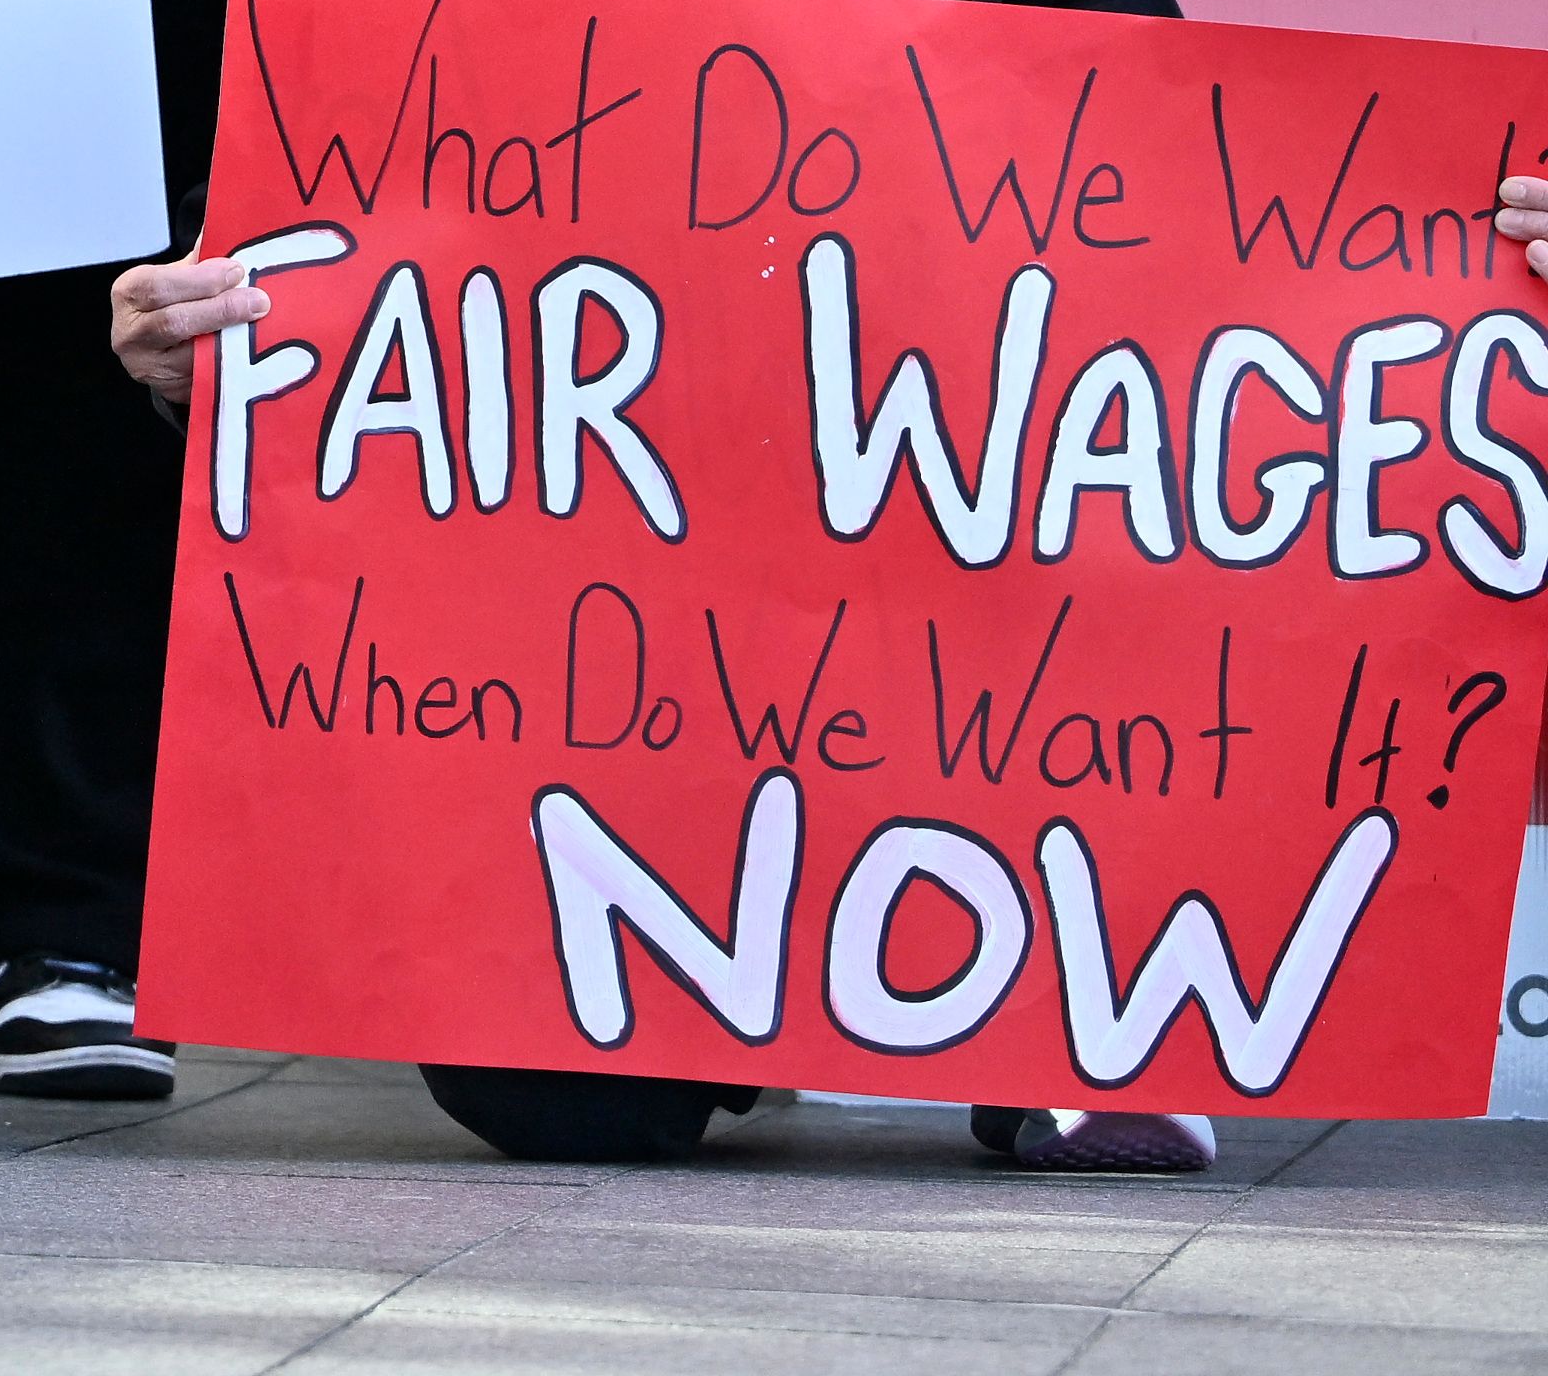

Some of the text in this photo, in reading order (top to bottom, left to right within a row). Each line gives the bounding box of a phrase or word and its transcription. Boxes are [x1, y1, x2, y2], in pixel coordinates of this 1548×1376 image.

[688, 43, 862, 233] Do
[908, 45, 1155, 256] We
[210, 220, 1548, 600] FAIR WAGES
[224, 570, 521, 748] When
[564, 581, 684, 754] Do
[704, 599, 887, 774] We
[929, 593, 1254, 800] Want
[530, 768, 1399, 1098] NOW
